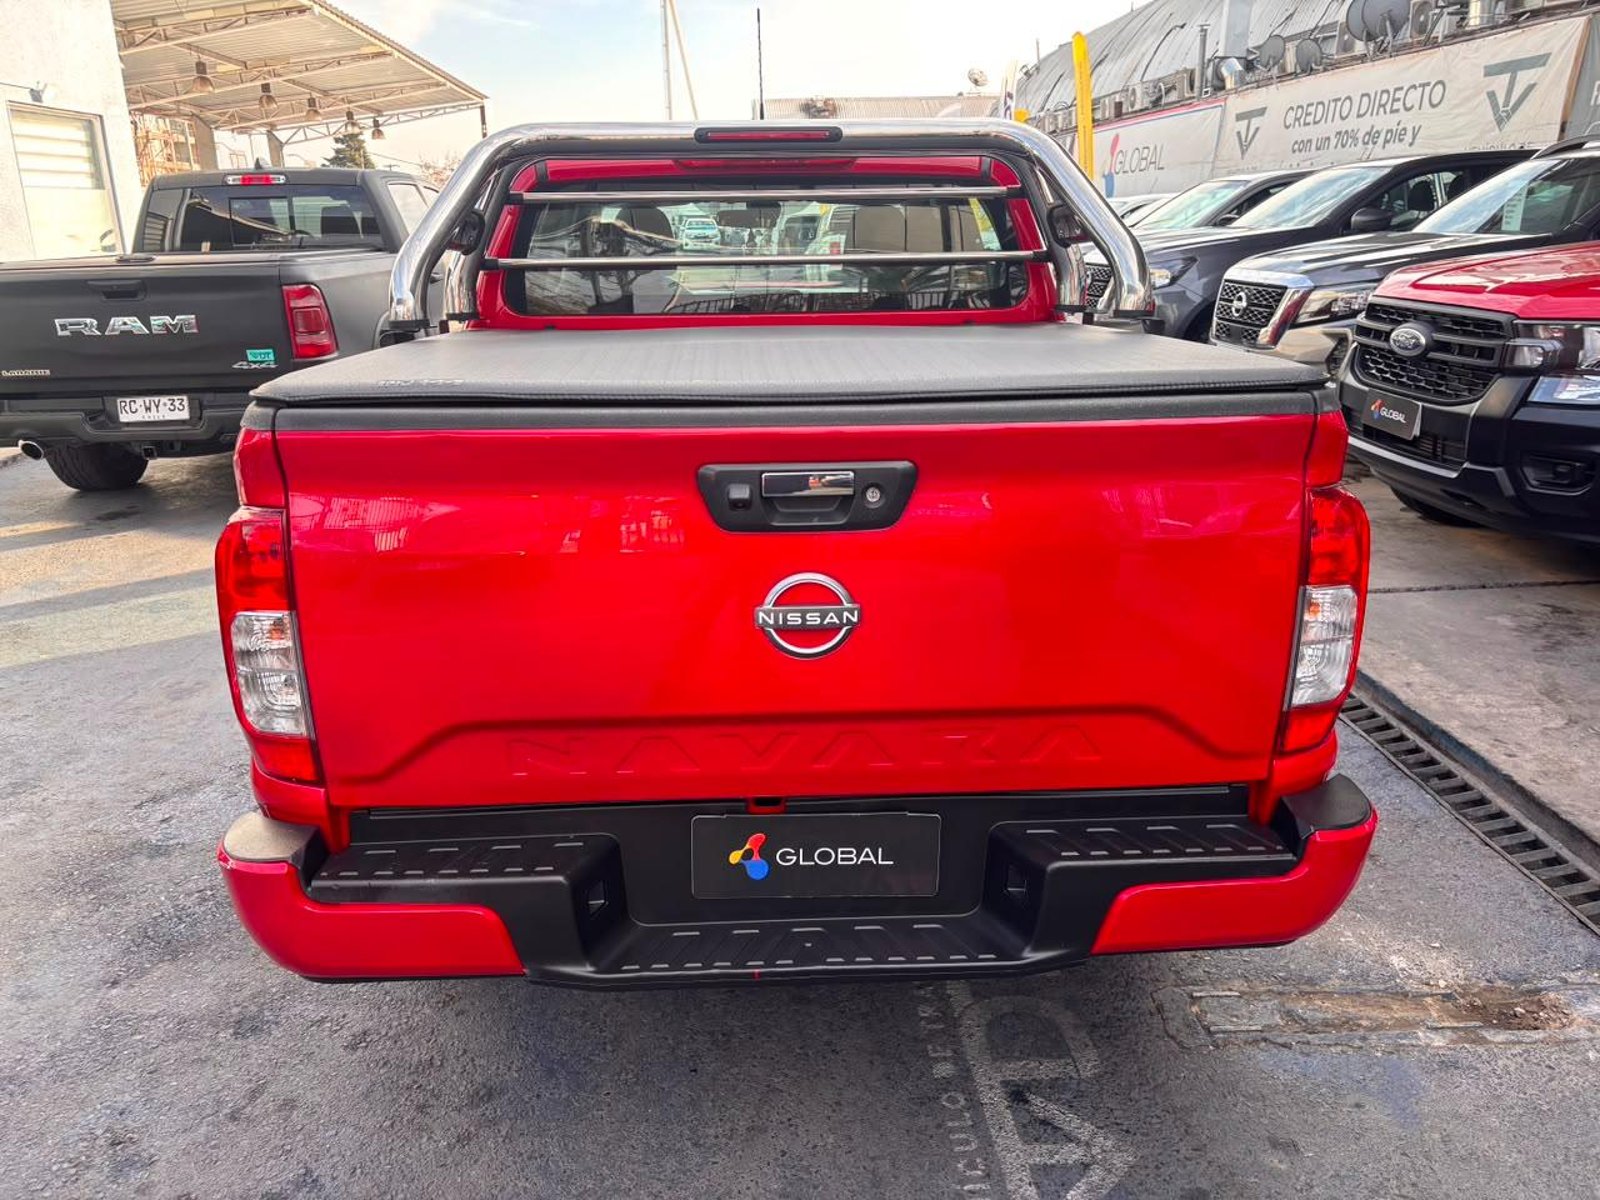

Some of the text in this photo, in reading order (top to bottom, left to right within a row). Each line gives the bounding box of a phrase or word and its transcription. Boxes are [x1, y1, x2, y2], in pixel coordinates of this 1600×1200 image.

[1283, 80, 1447, 129] CREDITO DIRECTO
[1291, 138, 1312, 154] con
[1315, 136, 1331, 150] un
[1334, 128, 1359, 149] 70%
[1362, 125, 1382, 146] de
[1408, 124, 1422, 147] y
[1114, 144, 1165, 175] GLOBAL
[54, 315, 200, 336] RAM
[1380, 407, 1407, 423] GLOBAL
[758, 610, 859, 625] NISSAN
[508, 726, 1103, 776] NAVARA
[775, 846, 895, 867] GLOBAL
